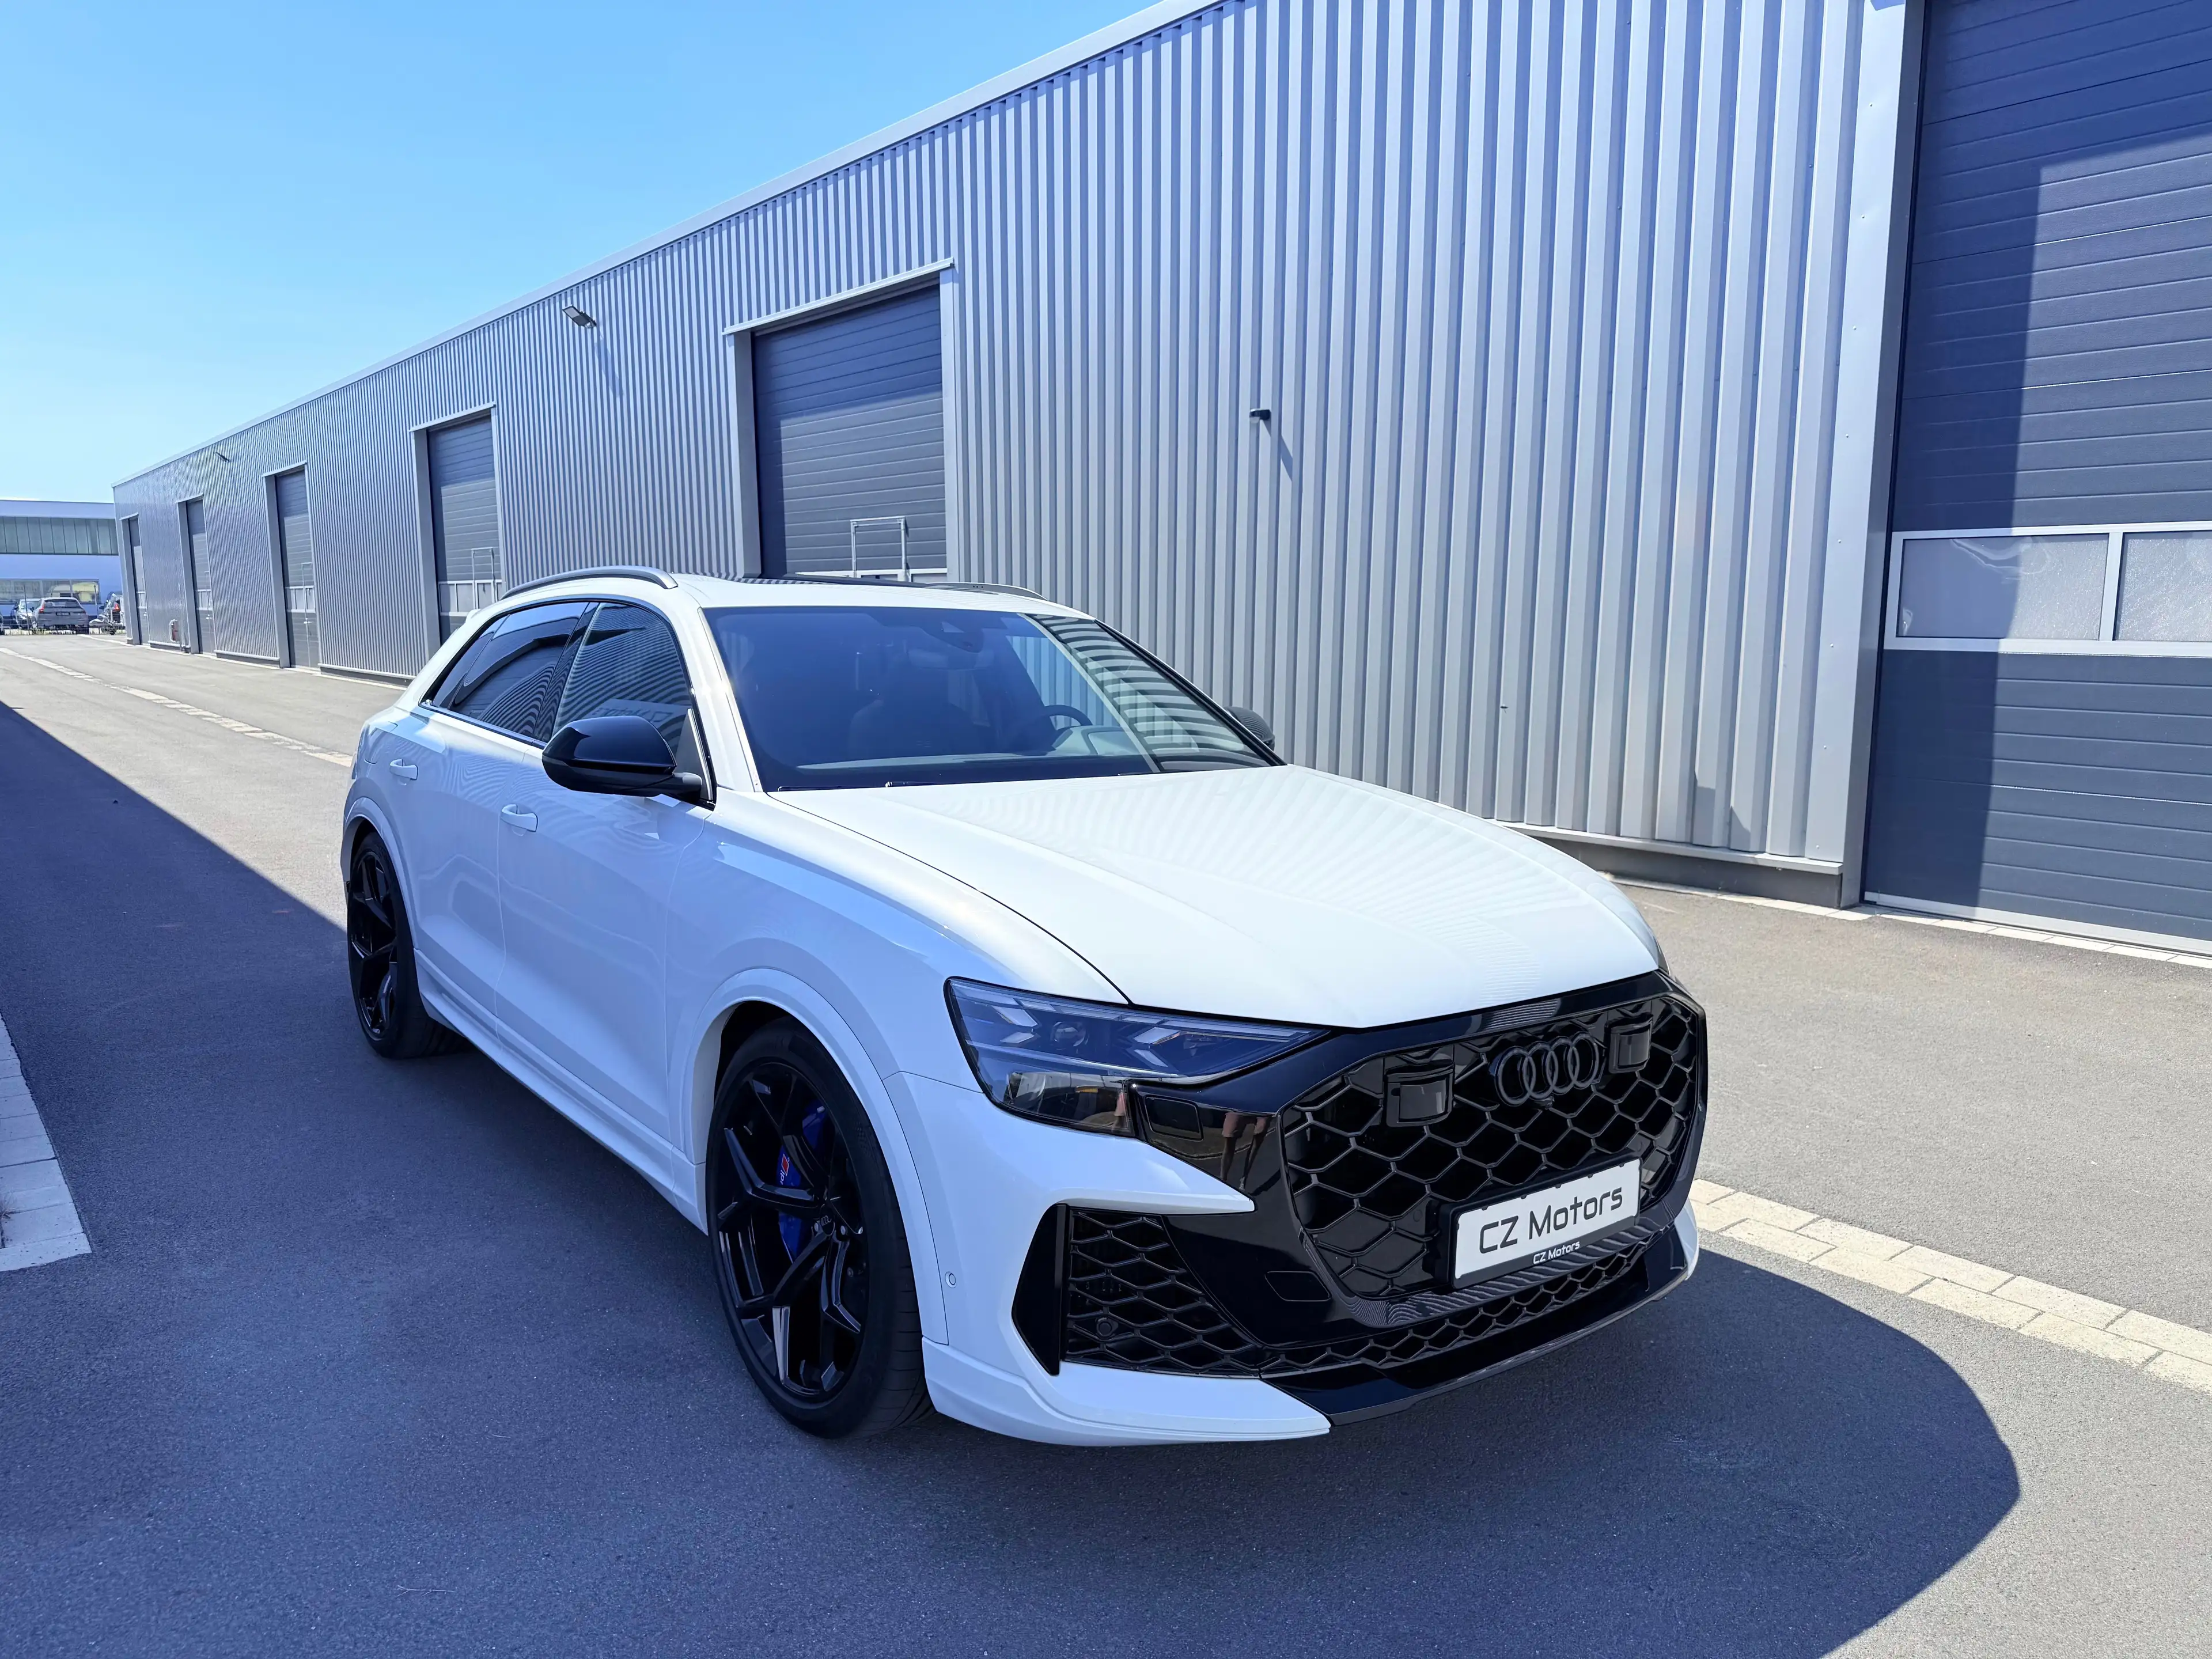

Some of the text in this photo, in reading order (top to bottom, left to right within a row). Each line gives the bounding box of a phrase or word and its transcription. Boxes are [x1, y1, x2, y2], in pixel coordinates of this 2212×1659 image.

[1479, 1187, 1623, 1254] CZ Motors
[1532, 1241, 1580, 1264] CZ Motors
